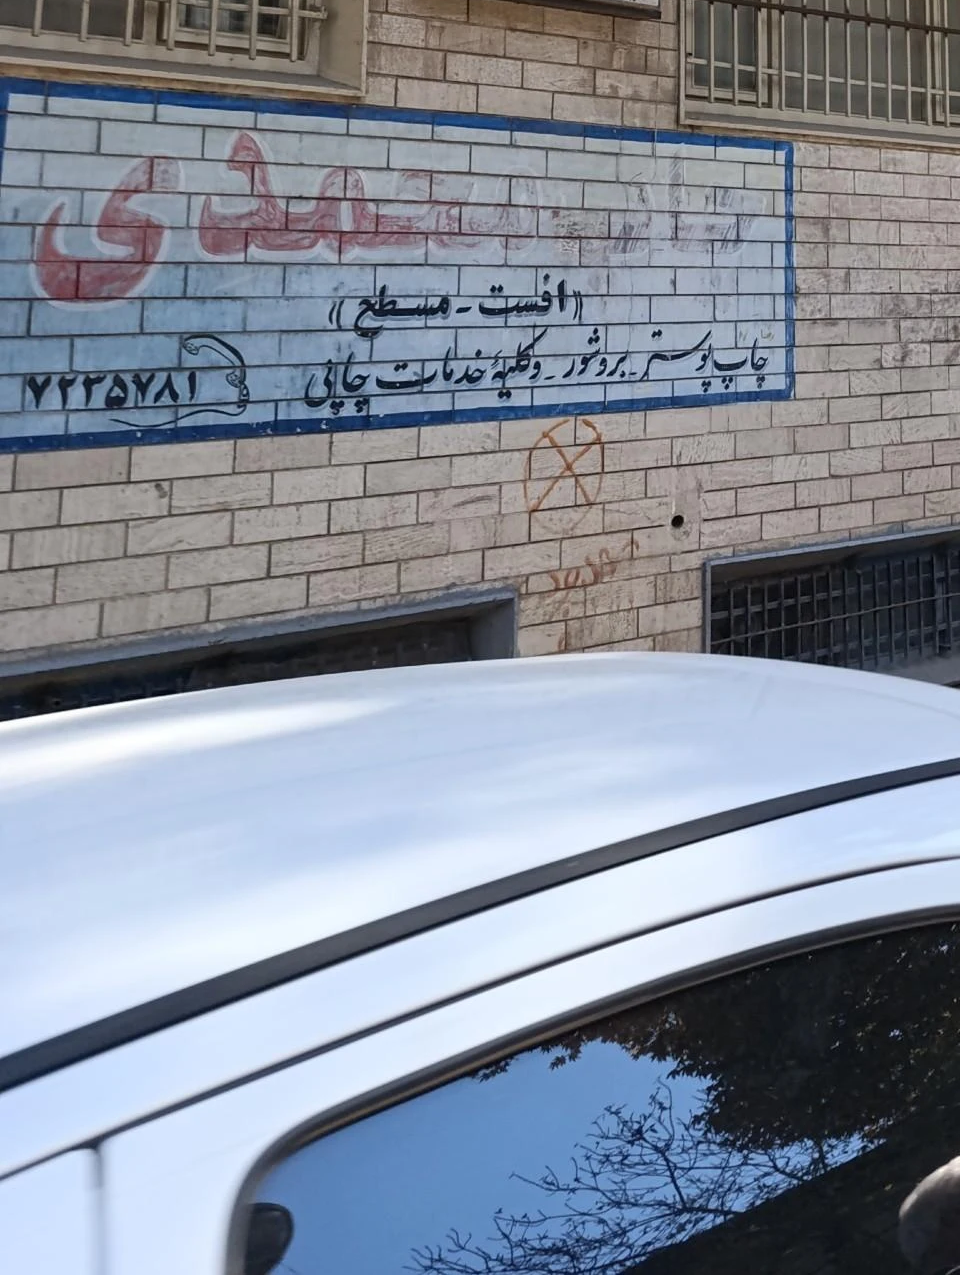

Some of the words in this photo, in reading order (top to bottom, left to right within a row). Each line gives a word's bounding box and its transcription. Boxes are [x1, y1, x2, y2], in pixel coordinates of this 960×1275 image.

[376, 346, 487, 390] خدمات
[562, 327, 629, 379] بروشور
[639, 329, 712, 393] پوستر
[713, 338, 769, 390] چاپ
[304, 352, 371, 416] چاپی
